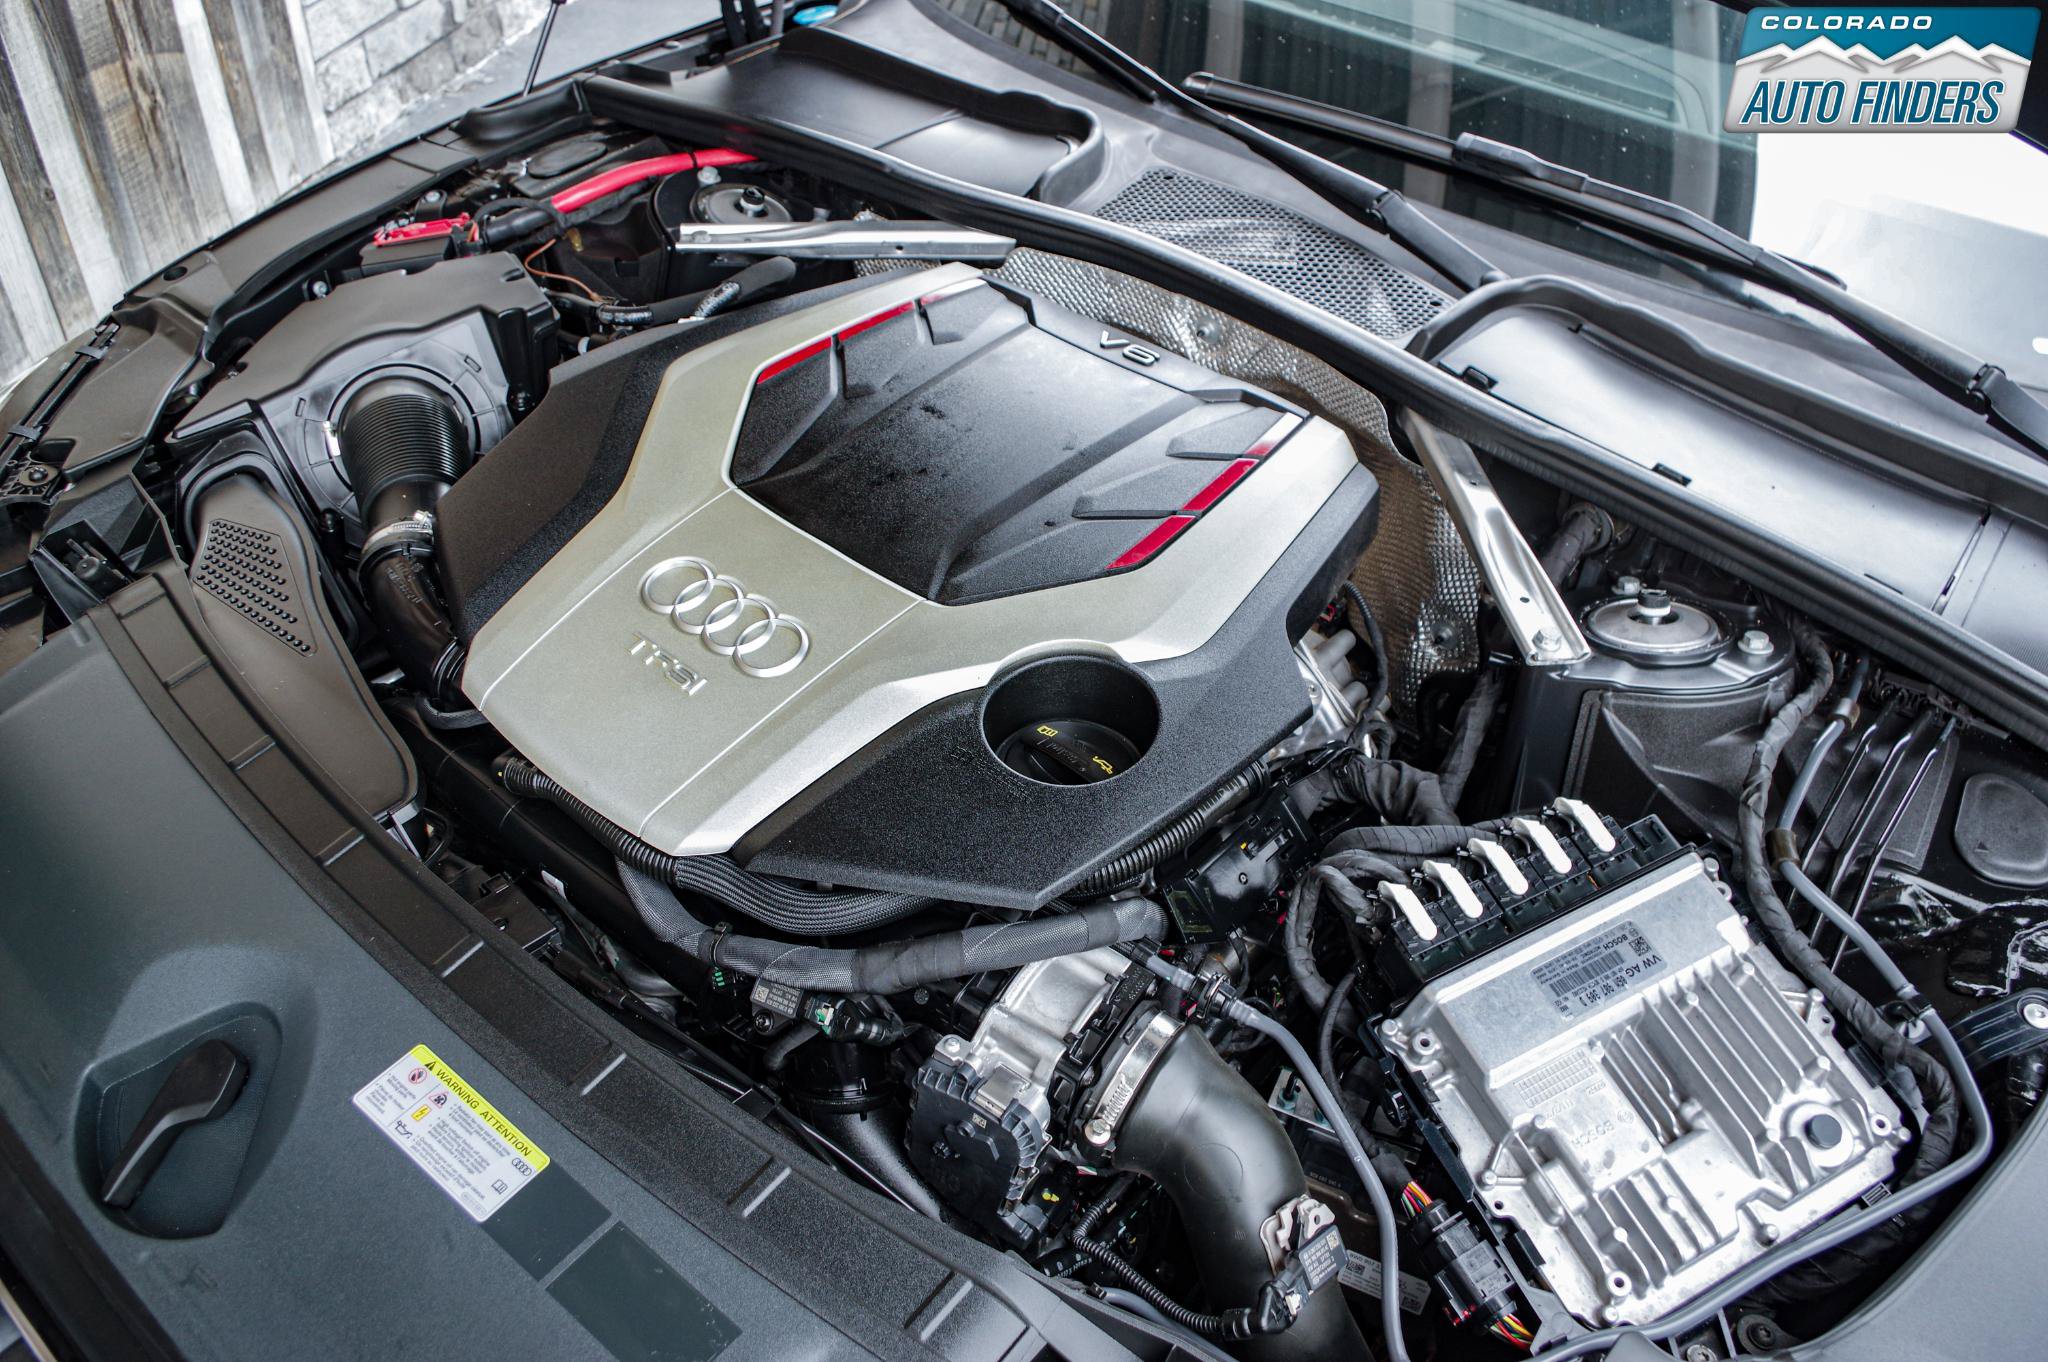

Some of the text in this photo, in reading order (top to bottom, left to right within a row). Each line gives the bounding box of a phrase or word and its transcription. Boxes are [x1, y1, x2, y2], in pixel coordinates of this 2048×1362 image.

[1100, 330, 1160, 366] V6
[625, 632, 708, 697] TFSI
[1603, 933, 1628, 951] BOSCH
[1625, 954, 1662, 978] VW AG
[436, 1069, 480, 1110] WARNING
[480, 1110, 532, 1157] ATTENTION
